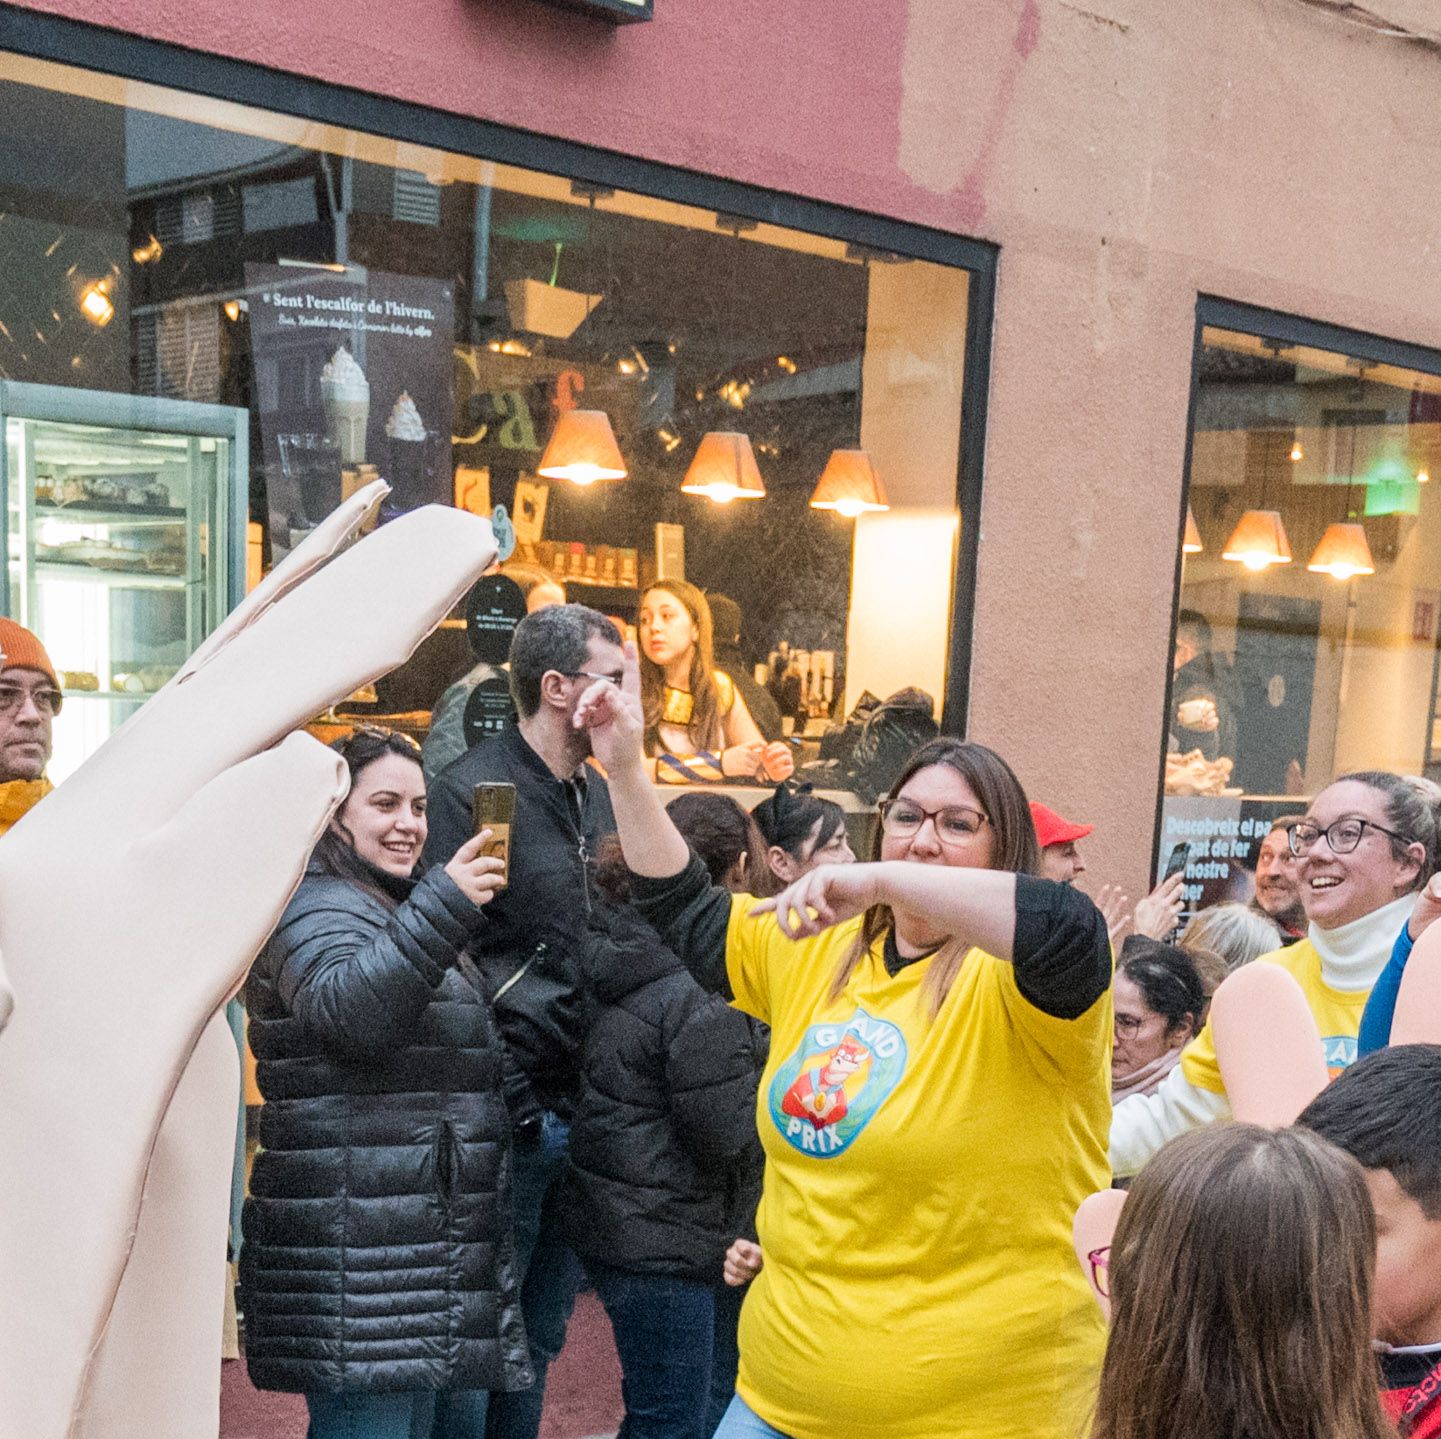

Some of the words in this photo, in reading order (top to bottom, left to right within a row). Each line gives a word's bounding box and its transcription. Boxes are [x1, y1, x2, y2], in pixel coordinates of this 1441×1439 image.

[273, 292, 303, 308] Sent
[306, 294, 364, 313] l'escalfor
[367, 299, 383, 314] de
[385, 301, 436, 321] l'hivern.
[1166, 816, 1240, 836] Descobreix
[1240, 818, 1255, 837] el
[1210, 839, 1230, 858] de
[1229, 840, 1251, 858] fer
[1186, 861, 1230, 879] nostre
[786, 1115, 844, 1153] PRIX
